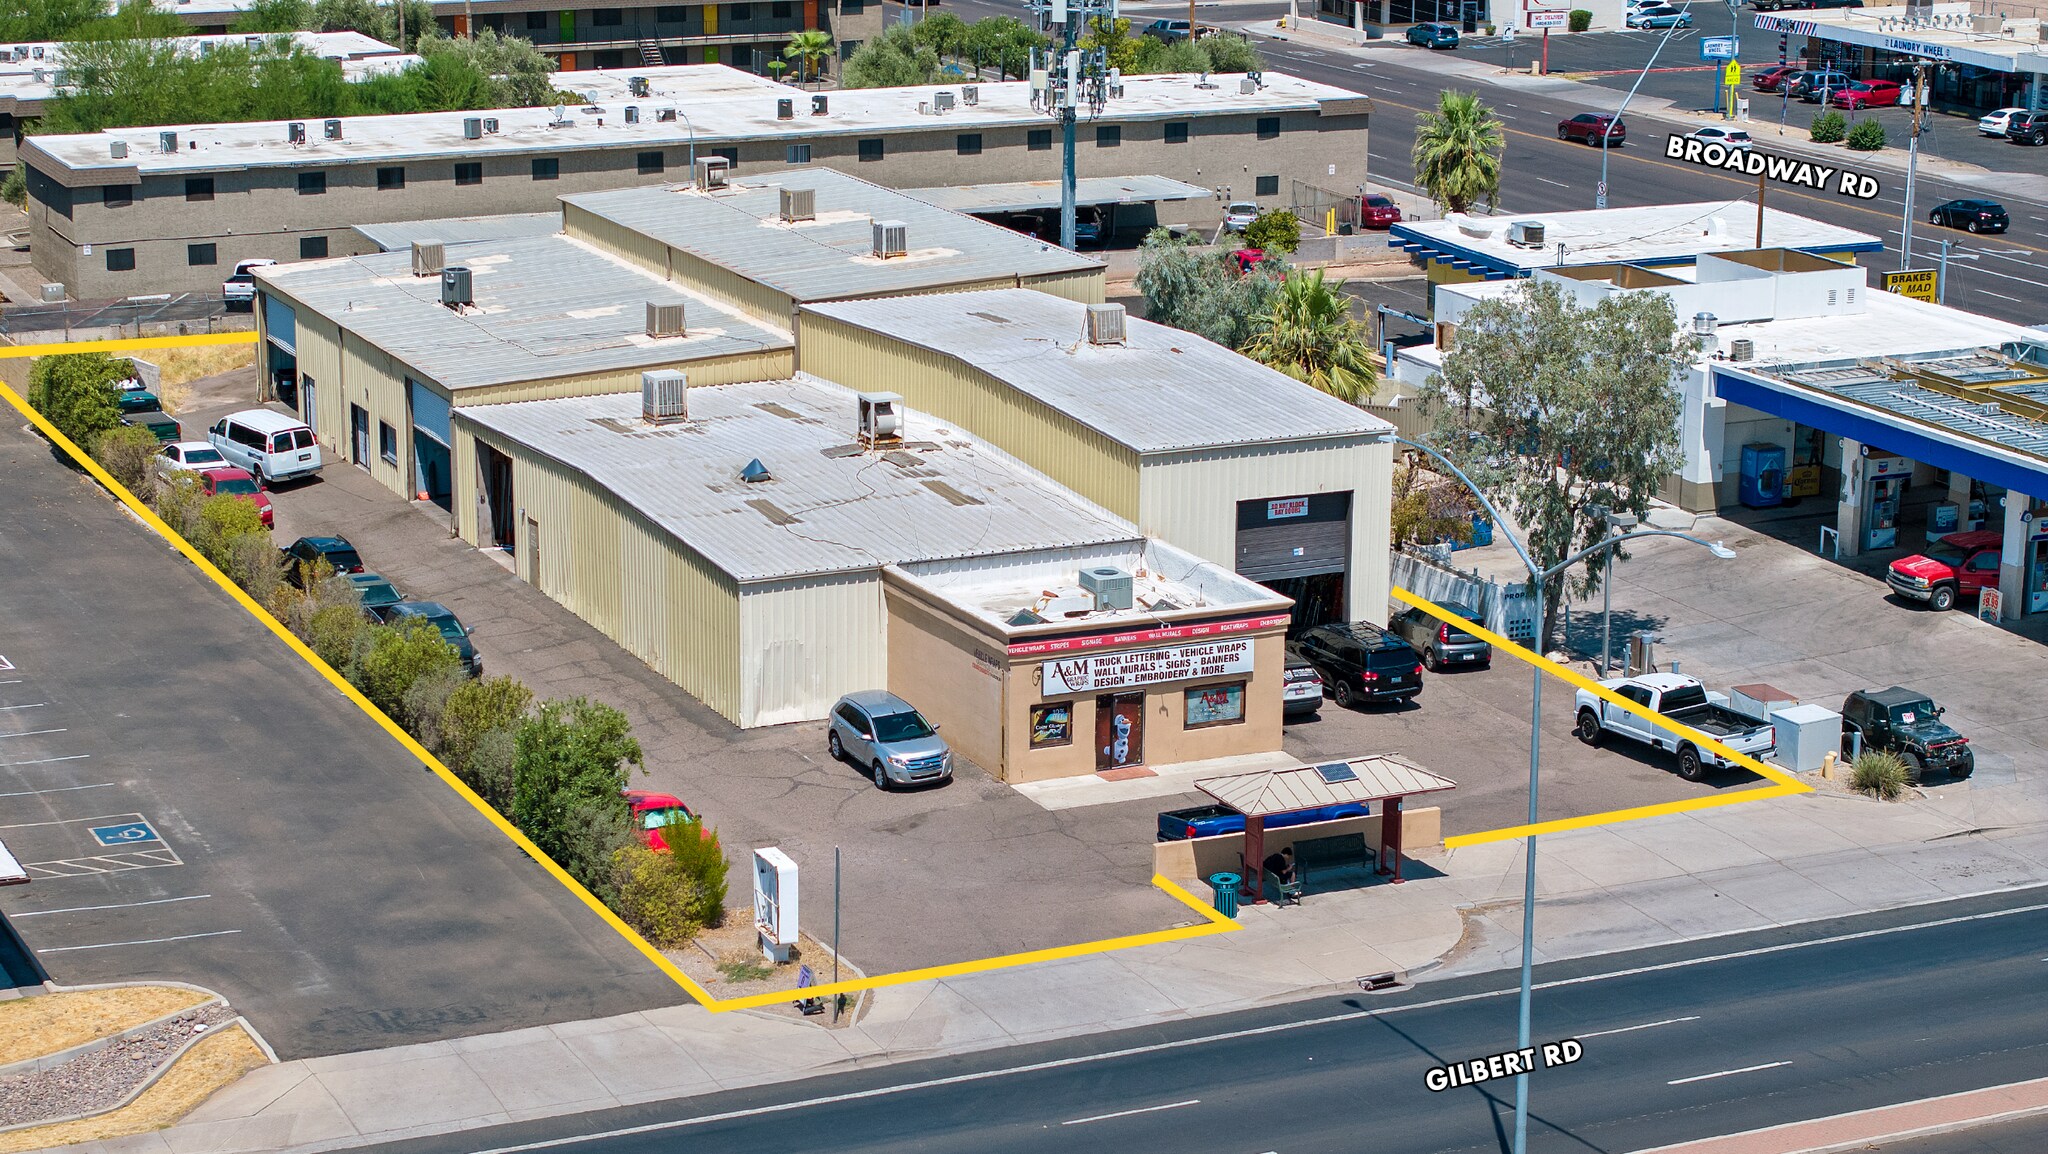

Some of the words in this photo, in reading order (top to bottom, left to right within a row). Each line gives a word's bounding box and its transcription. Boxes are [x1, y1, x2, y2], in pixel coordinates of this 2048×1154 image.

[1890, 39, 1921, 52] LAUNDRY
[1924, 45, 1944, 56] WHEEL
[1891, 272, 1932, 283] BRAKES
[1906, 283, 1932, 293] MAD
[1008, 646, 1028, 654] VEHICLE
[1028, 644, 1046, 653] WRAPS
[1050, 641, 1070, 650] STRIPES
[1081, 637, 1103, 646] SIGNAGE
[1114, 634, 1137, 642] BANNERS
[1162, 629, 1182, 637] MURALS
[1192, 626, 1210, 635] DESIGN
[1232, 622, 1249, 630] WRAPS
[1051, 659, 1090, 685] A&M
[1094, 656, 1122, 668] TRUCK
[1124, 650, 1170, 664] LETTERING
[1179, 646, 1214, 658] VEHICLE
[1216, 642, 1247, 654] WRAPS
[1094, 666, 1118, 678] WALL
[1120, 662, 1156, 674] MURALS
[1166, 658, 1191, 670] SIGNS
[1200, 653, 1240, 666] BANNERS
[1094, 678, 1125, 688] DESIGN
[1135, 668, 1189, 683] EMBROIDERY
[1191, 667, 1198, 676] &
[1201, 664, 1225, 675] MORE
